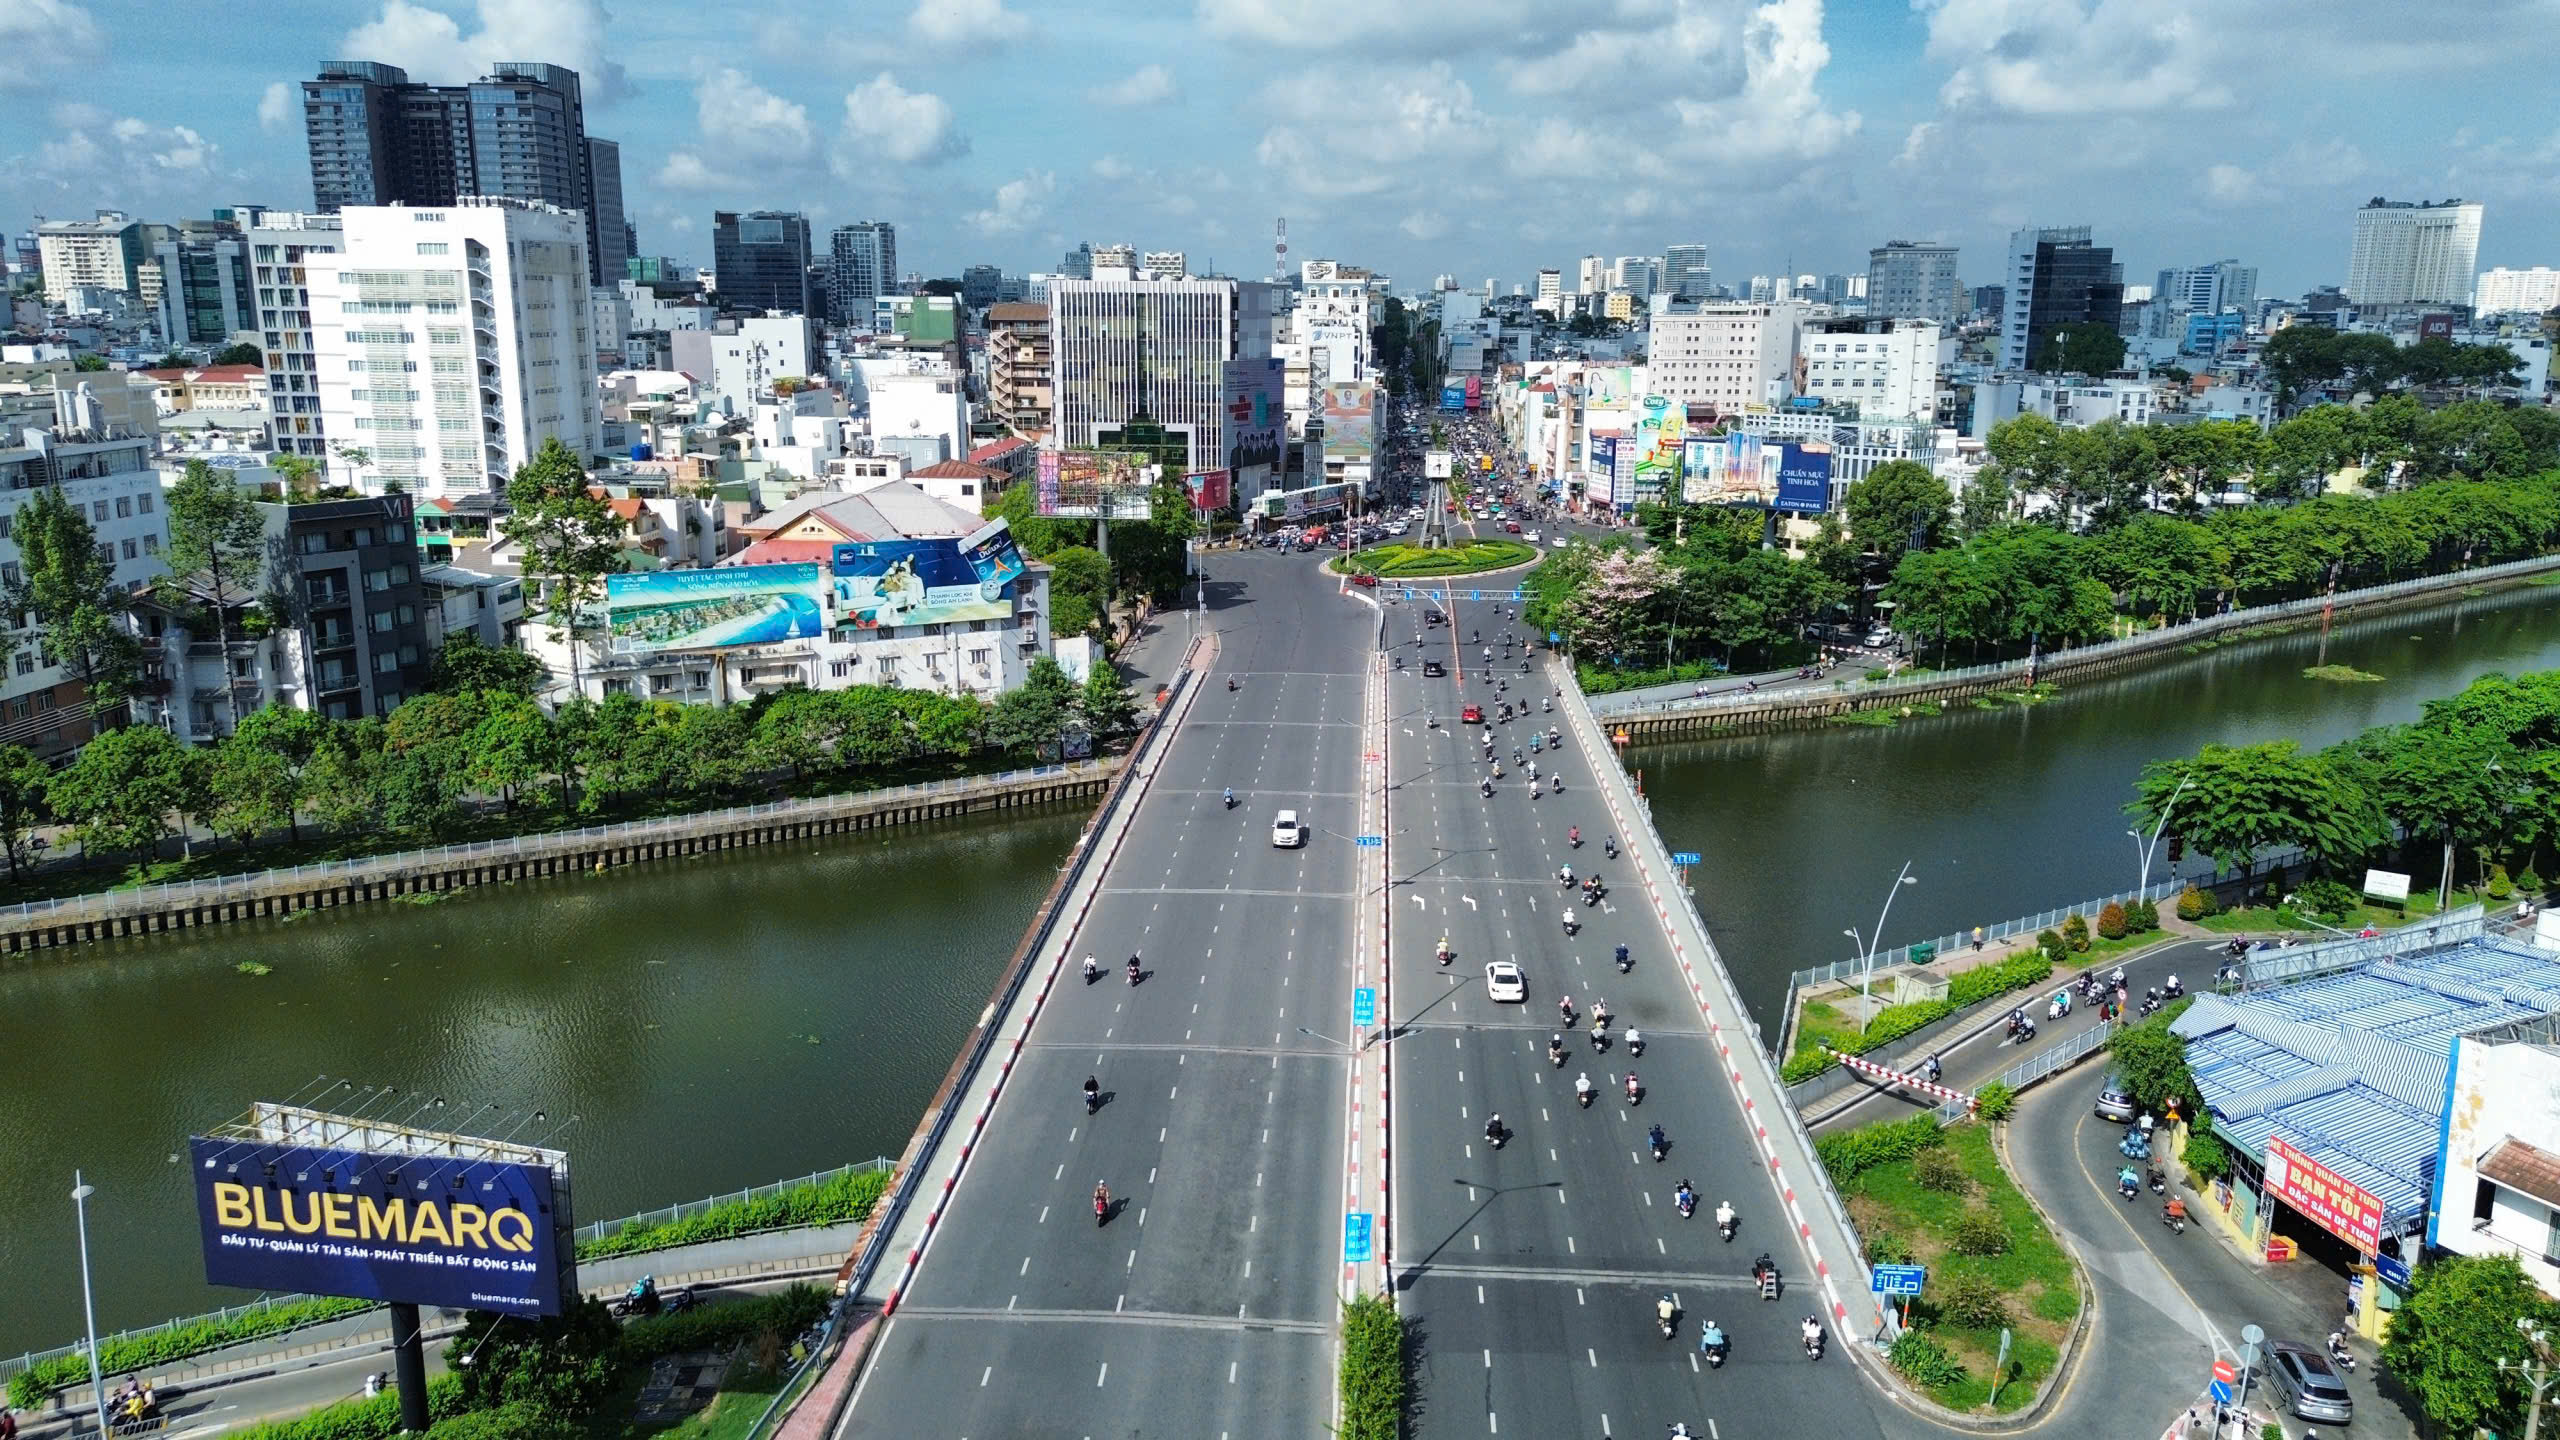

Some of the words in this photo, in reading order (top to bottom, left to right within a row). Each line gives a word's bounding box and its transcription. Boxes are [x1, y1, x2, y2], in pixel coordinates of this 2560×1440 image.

[1803, 479, 1819, 487] HOA
[2270, 1138, 2283, 1154] HỆ
[2284, 1148, 2314, 1169] THỐNG
[2315, 1166, 2342, 1189] QUÁN
[2342, 1183, 2357, 1198] DÊ
[2358, 1194, 2380, 1212] TƯƠI
[2289, 1165, 2327, 1201] BẠN
[2328, 1188, 2361, 1222] TÔI
[213, 1181, 534, 1253] BLUEMARQ
[2288, 1185, 2309, 1206] ĐẶC
[2310, 1199, 2332, 1220] SẢN
[2333, 1212, 2349, 1229] DÊ
[2350, 1223, 2375, 1246] TƯƠI
[306, 1242, 321, 1254] LÝ
[322, 1244, 342, 1256] TÀI
[408, 1252, 444, 1265] TRIỂN
[446, 1253, 470, 1267] BẤT
[472, 1257, 509, 1271] ĐỘNG
[511, 1260, 537, 1273] SẢN
[471, 1292, 540, 1306] bluemarq.com
